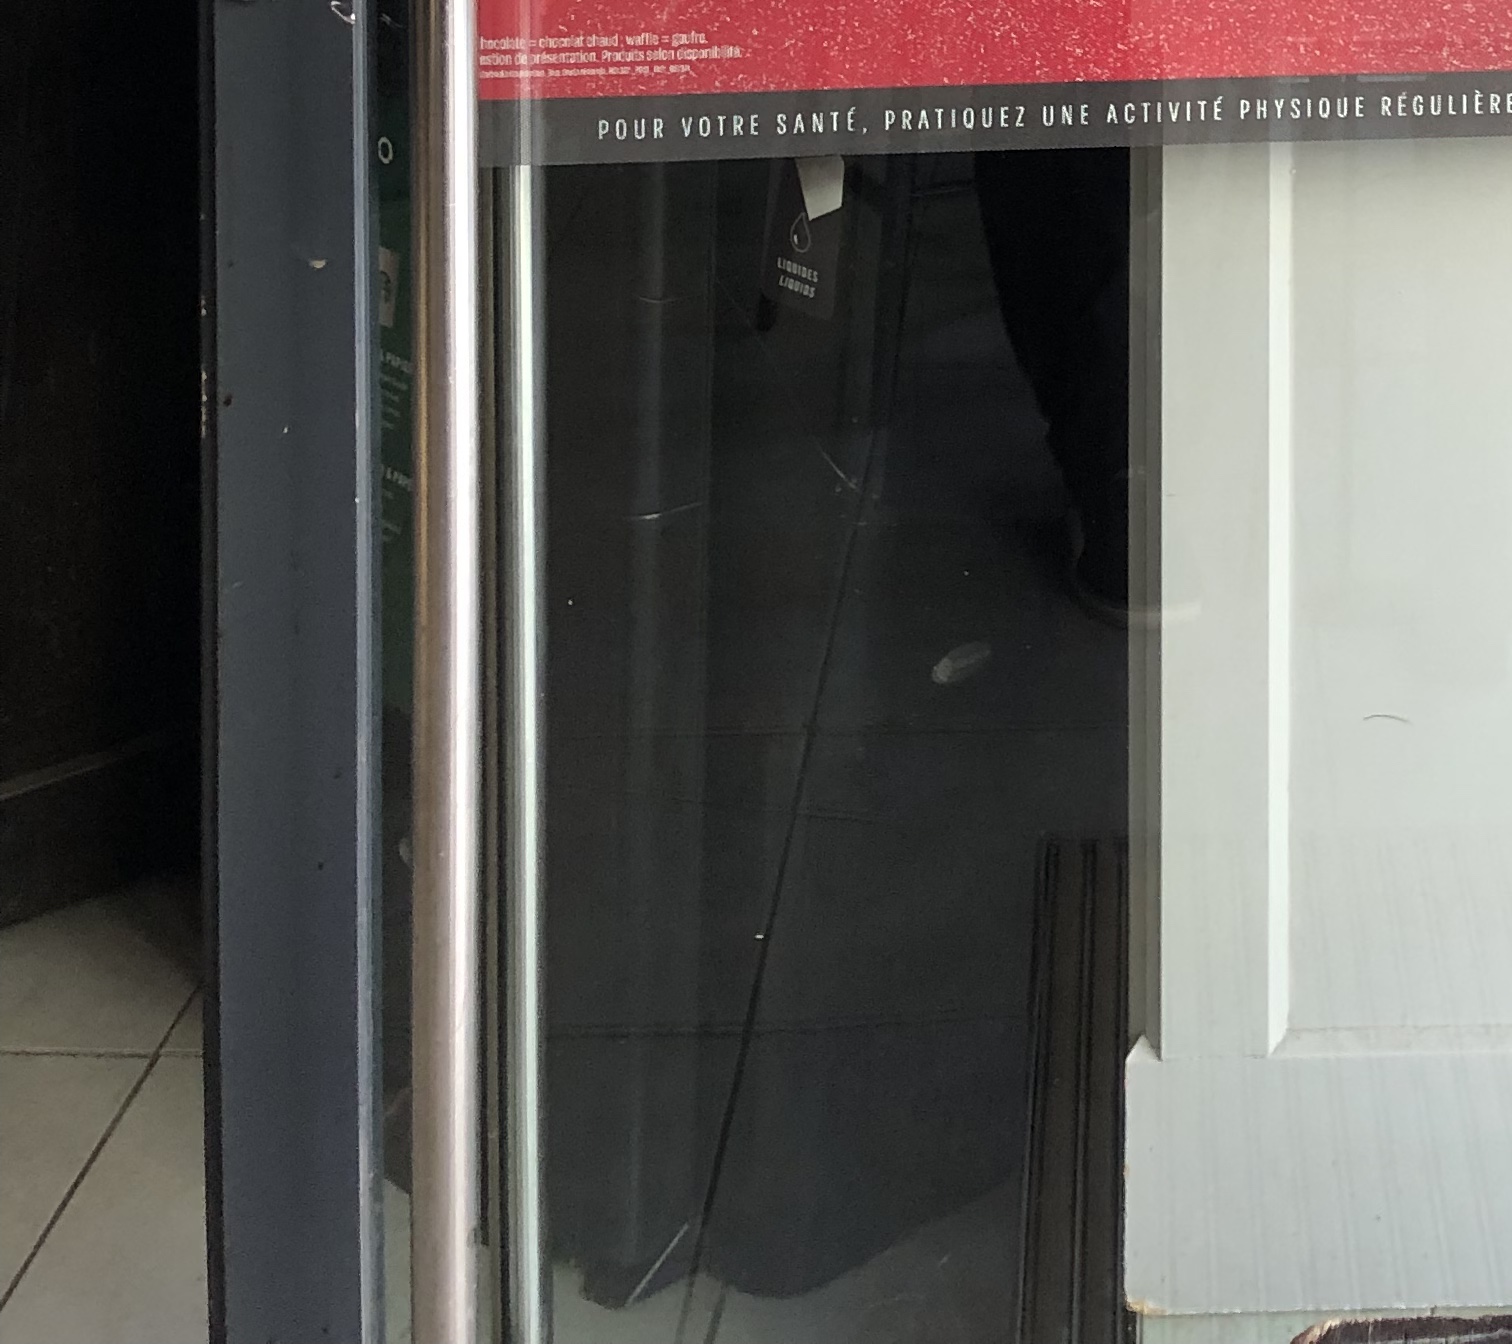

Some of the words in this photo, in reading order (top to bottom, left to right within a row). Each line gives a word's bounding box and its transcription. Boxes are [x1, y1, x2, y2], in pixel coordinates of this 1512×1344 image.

[597, 118, 666, 140] POUR
[681, 115, 760, 137] VOTRE
[776, 107, 869, 134] SANTÉ,
[883, 104, 1026, 132] PRATIQUEZ
[1041, 103, 1090, 128] UNE
[1105, 96, 1225, 125] ACTIVITÉ
[1240, 95, 1365, 119] PHYSIQUE
[777, 256, 818, 283] LIQUIDES
[778, 275, 816, 298] LIQUIDS
